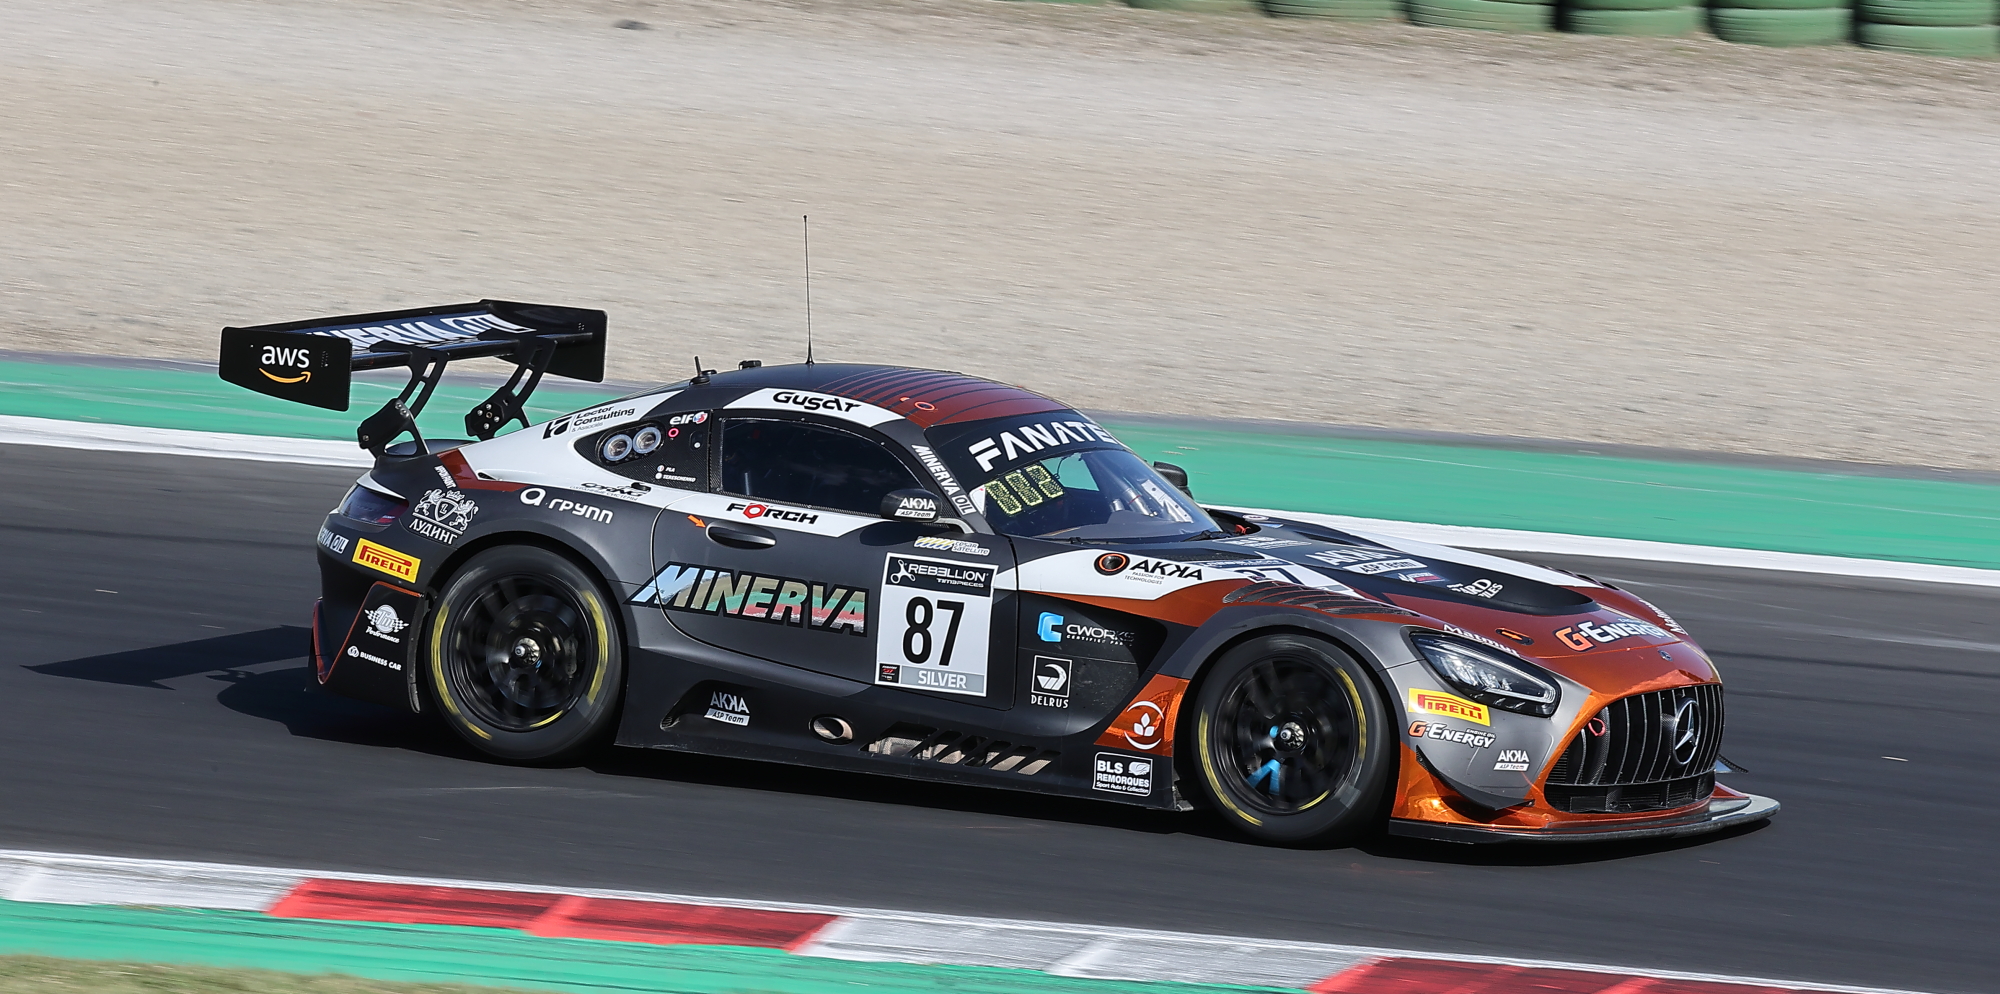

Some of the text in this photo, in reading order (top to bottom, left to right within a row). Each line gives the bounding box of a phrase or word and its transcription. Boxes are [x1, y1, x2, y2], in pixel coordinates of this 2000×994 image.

[261, 345, 310, 369] aws
[574, 408, 635, 426] Consulting
[576, 406, 614, 419] Lector
[670, 414, 694, 425] elf
[911, 444, 977, 515] MINERVA OIL
[899, 498, 936, 510] AKKA
[409, 518, 458, 545] ЛУДИНГ
[330, 534, 349, 554] OIL
[359, 545, 412, 576] PIRELLI
[1129, 559, 1202, 580] AKKA
[908, 563, 986, 583] REBELLION
[1132, 571, 1155, 580] PASSION
[631, 564, 866, 634] MINERVA
[902, 596, 965, 667] 87
[360, 651, 402, 671] BUSINESS CAR
[918, 670, 967, 689] SILVER
[710, 691, 749, 713] AKKA
[1031, 695, 1069, 709] DELRUS
[1417, 693, 1482, 720] PIRELLI
[712, 711, 745, 723] ASP Team
[1466, 728, 1487, 736] ENGINE
[1497, 749, 1530, 762] AKKA
[1097, 760, 1123, 774] BLS
[1096, 773, 1150, 788] REMORQUES
